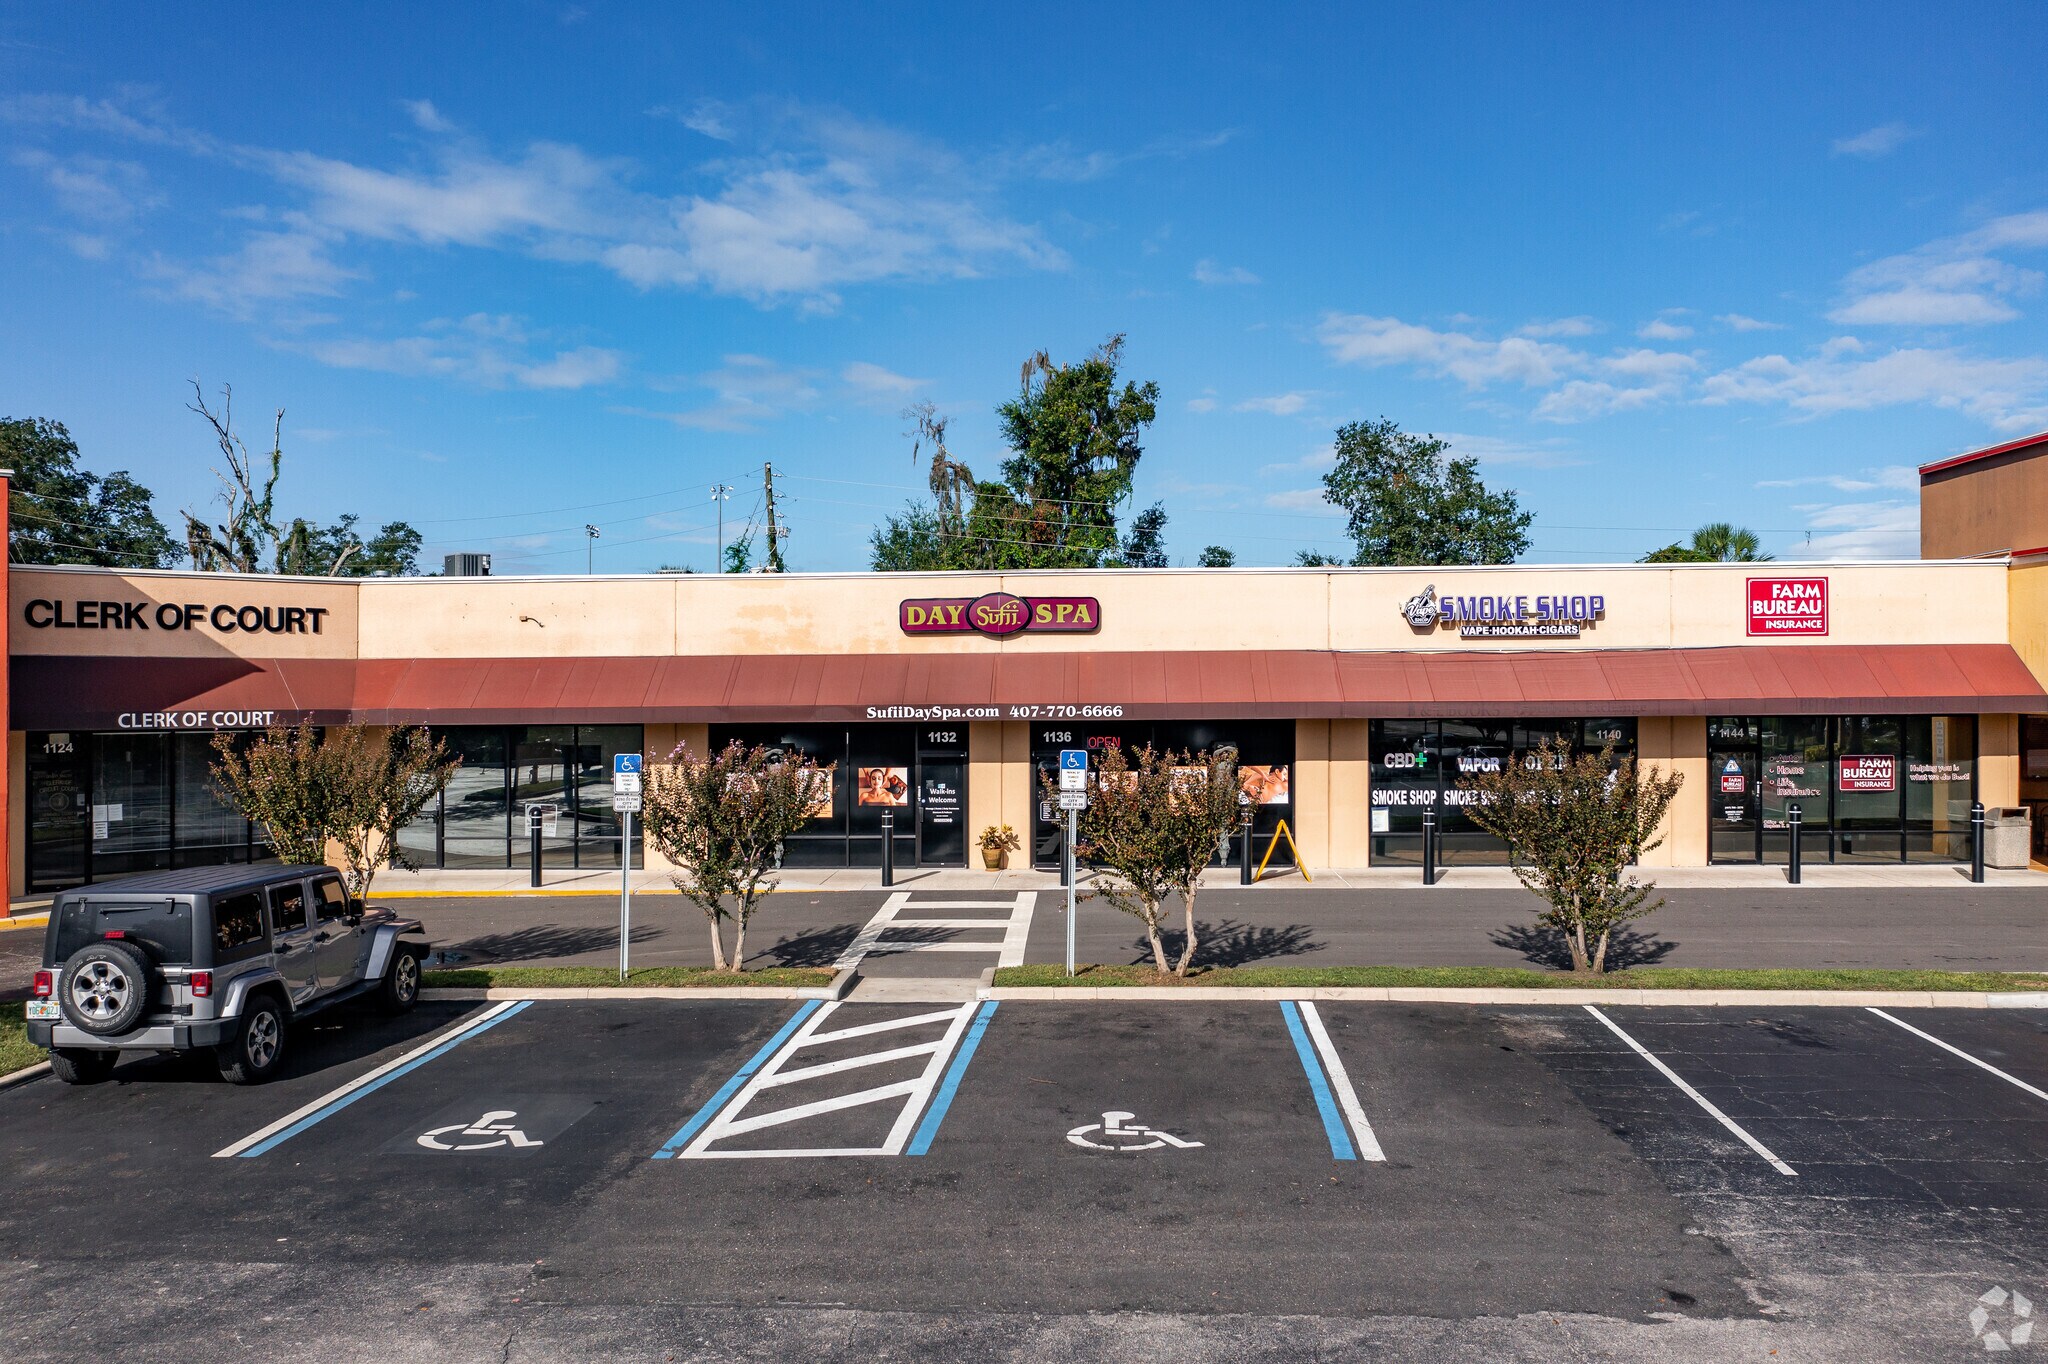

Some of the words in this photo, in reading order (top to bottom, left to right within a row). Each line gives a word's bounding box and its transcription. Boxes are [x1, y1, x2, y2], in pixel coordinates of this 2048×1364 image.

[1772, 584, 1821, 598] FARM
[1407, 604, 1435, 616] Vape
[1440, 596, 1529, 620] SMOKE
[1536, 595, 1605, 620] SHOP
[1752, 600, 1822, 614] BUREAU
[24, 599, 149, 630] CLERK
[155, 603, 205, 630] OF
[210, 604, 326, 632] COURT
[906, 605, 964, 626] DAY
[1036, 604, 1092, 624] SPA
[1766, 620, 1822, 628] INSURANCE
[866, 706, 1000, 720] SufiiDaySpa.com
[1010, 705, 1123, 718] 407-770-6666
[118, 713, 178, 728] CLERK
[182, 712, 208, 727] OF
[212, 711, 274, 726] COURT
[928, 732, 957, 742] 1132
[1043, 731, 1072, 742] 1136
[1596, 730, 1622, 740] 1140
[1719, 728, 1744, 738] 1144
[43, 742, 74, 753] 1124
[1088, 736, 1120, 748] OPEN
[1776, 754, 1800, 762] Auto
[1859, 758, 1892, 768] FARM
[1457, 757, 1500, 772] VAPOR
[1776, 766, 1804, 774] Home
[1842, 768, 1892, 778] BUREAU
[1854, 780, 1891, 788] INSURANCE
[1372, 790, 1408, 805] SMOKE
[1410, 790, 1437, 805] SHOP
[1776, 788, 1821, 796] Insurance
